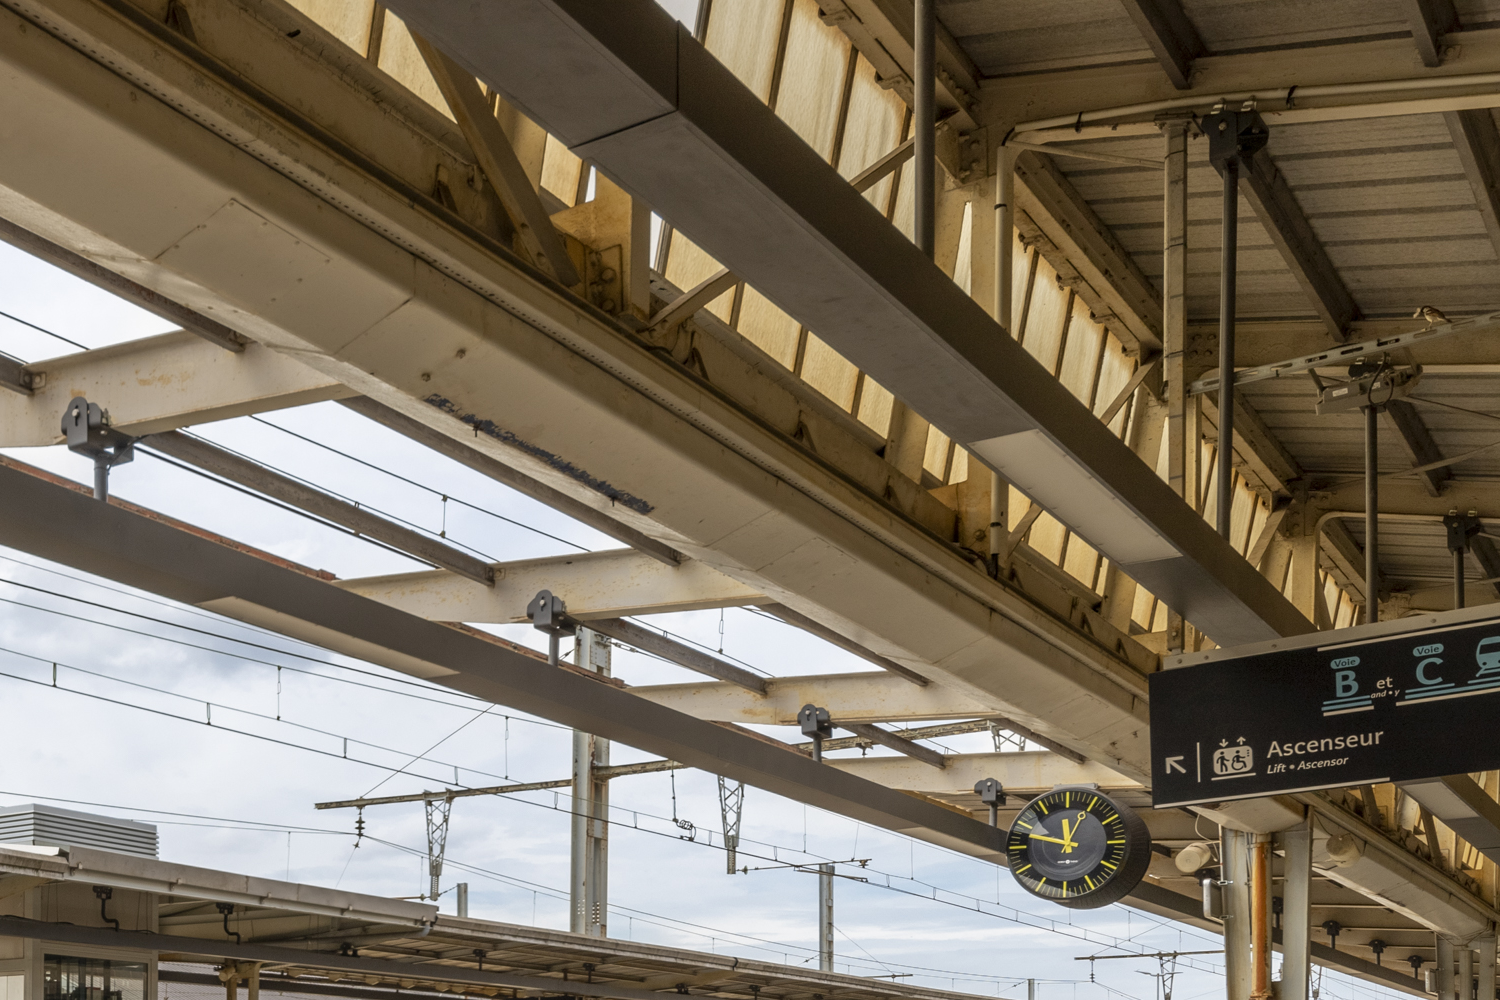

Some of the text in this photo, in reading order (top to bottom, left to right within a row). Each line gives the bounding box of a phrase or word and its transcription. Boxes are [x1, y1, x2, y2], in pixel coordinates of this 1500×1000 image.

[1416, 646, 1440, 655] Voie
[1334, 659, 1356, 668] Voie
[1335, 657, 1444, 698] B et C
[1370, 690, 1387, 699] and
[1266, 731, 1384, 759] Ascenseur
[1266, 757, 1349, 774] Lift Ascensor
